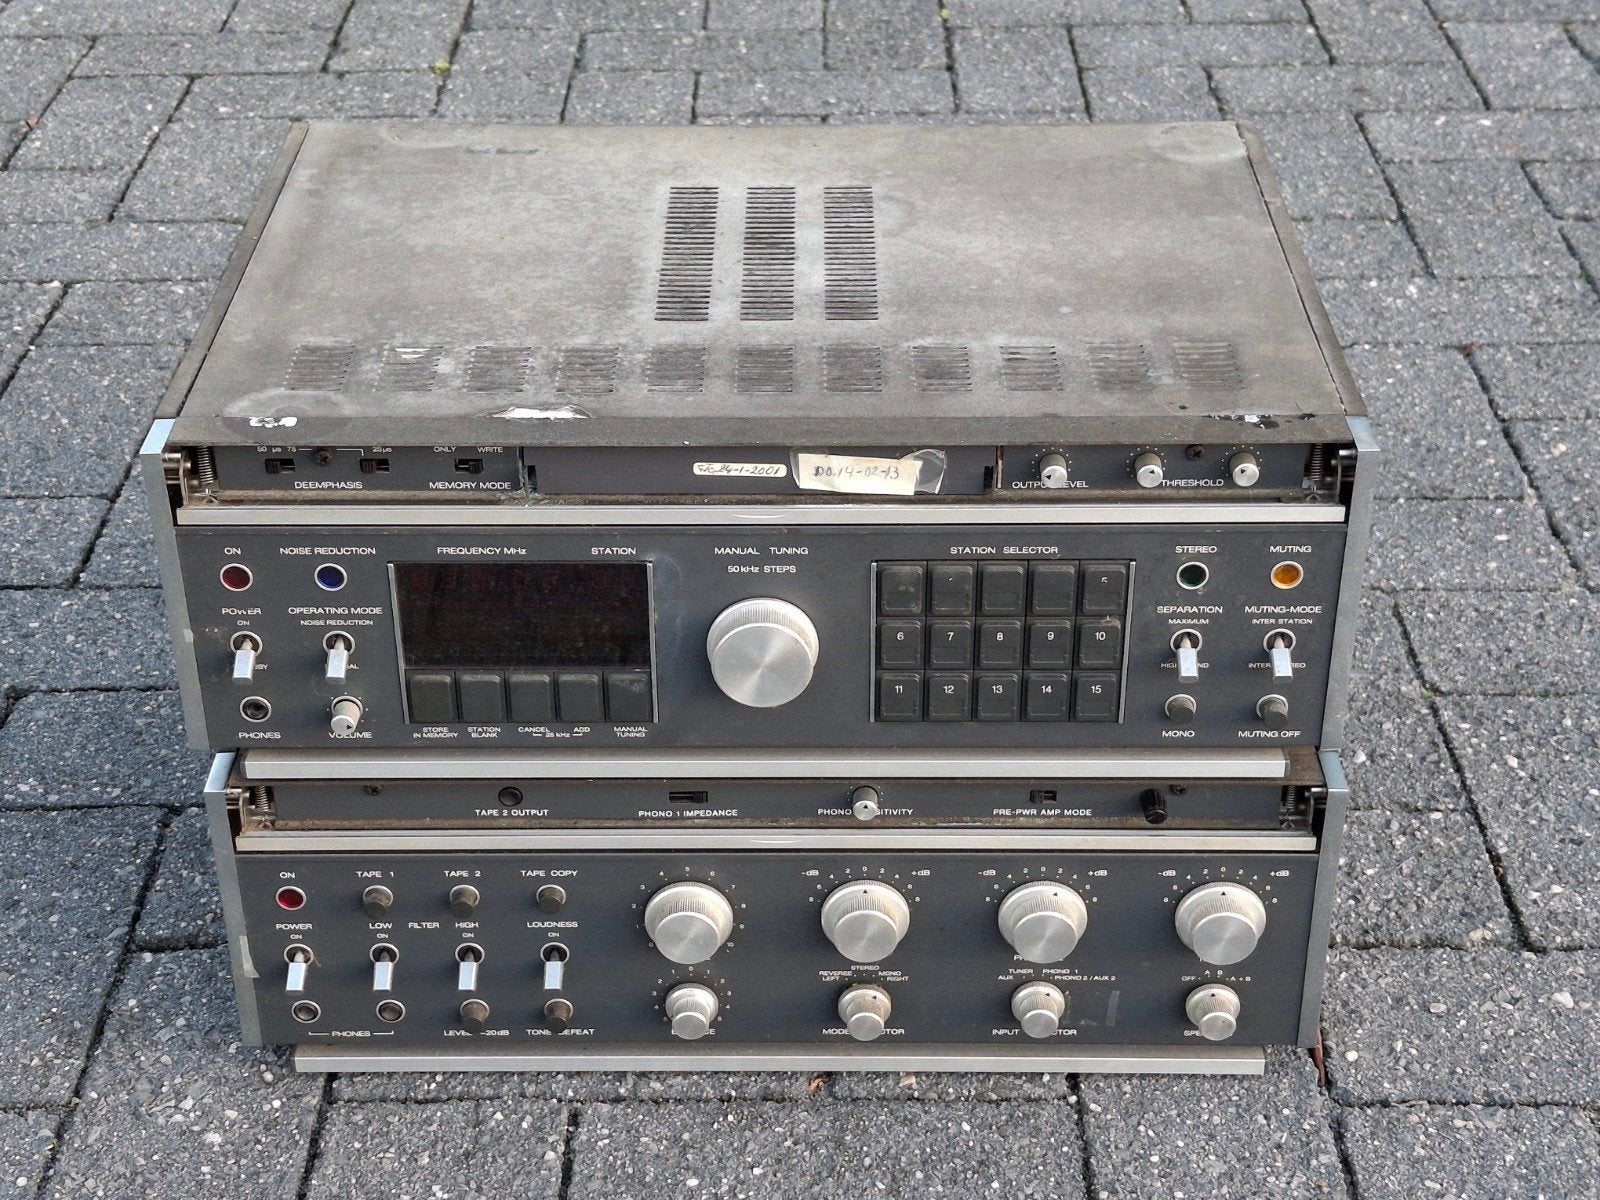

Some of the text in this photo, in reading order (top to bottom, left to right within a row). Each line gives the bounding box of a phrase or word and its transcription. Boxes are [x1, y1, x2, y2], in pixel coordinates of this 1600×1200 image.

[294, 481, 363, 490] DEEMPHASIS
[429, 481, 512, 490] MEMORY MODE
[1161, 479, 1224, 487] THRESHOLD
[224, 547, 242, 555] ON
[279, 547, 376, 555] NOISE REDUCTION
[437, 547, 527, 556] FREQUENCY MHz
[591, 547, 636, 555] STATION
[714, 547, 809, 555] MANUAL TUNING
[950, 546, 1059, 555] STATION SELECTOR
[1175, 545, 1217, 554] STEREO
[1269, 545, 1312, 553] MUTING
[763, 565, 797, 573] STEPS
[288, 607, 383, 615] OPERATING MODE
[1156, 605, 1223, 614] SEPARATION
[1244, 605, 1322, 614] MUTING-MODE
[896, 632, 904, 641] 6
[947, 632, 954, 641] 7
[996, 632, 1004, 641] 8
[1047, 632, 1055, 641] 9
[1095, 632, 1106, 641] 10
[894, 685, 903, 694] 11
[943, 685, 955, 694] 12
[991, 685, 1003, 694] 13
[1041, 685, 1052, 694] 14
[1091, 685, 1102, 694] 15
[238, 731, 281, 739] PHONES
[1162, 730, 1195, 738] MONO
[1238, 730, 1302, 738] MUTING OFF
[638, 810, 673, 818] PHONO
[683, 809, 739, 817] IMPEDANCE
[817, 808, 852, 816] PHONO
[992, 808, 1092, 816] PRE-PWR AMP MODE
[279, 871, 296, 879] ON
